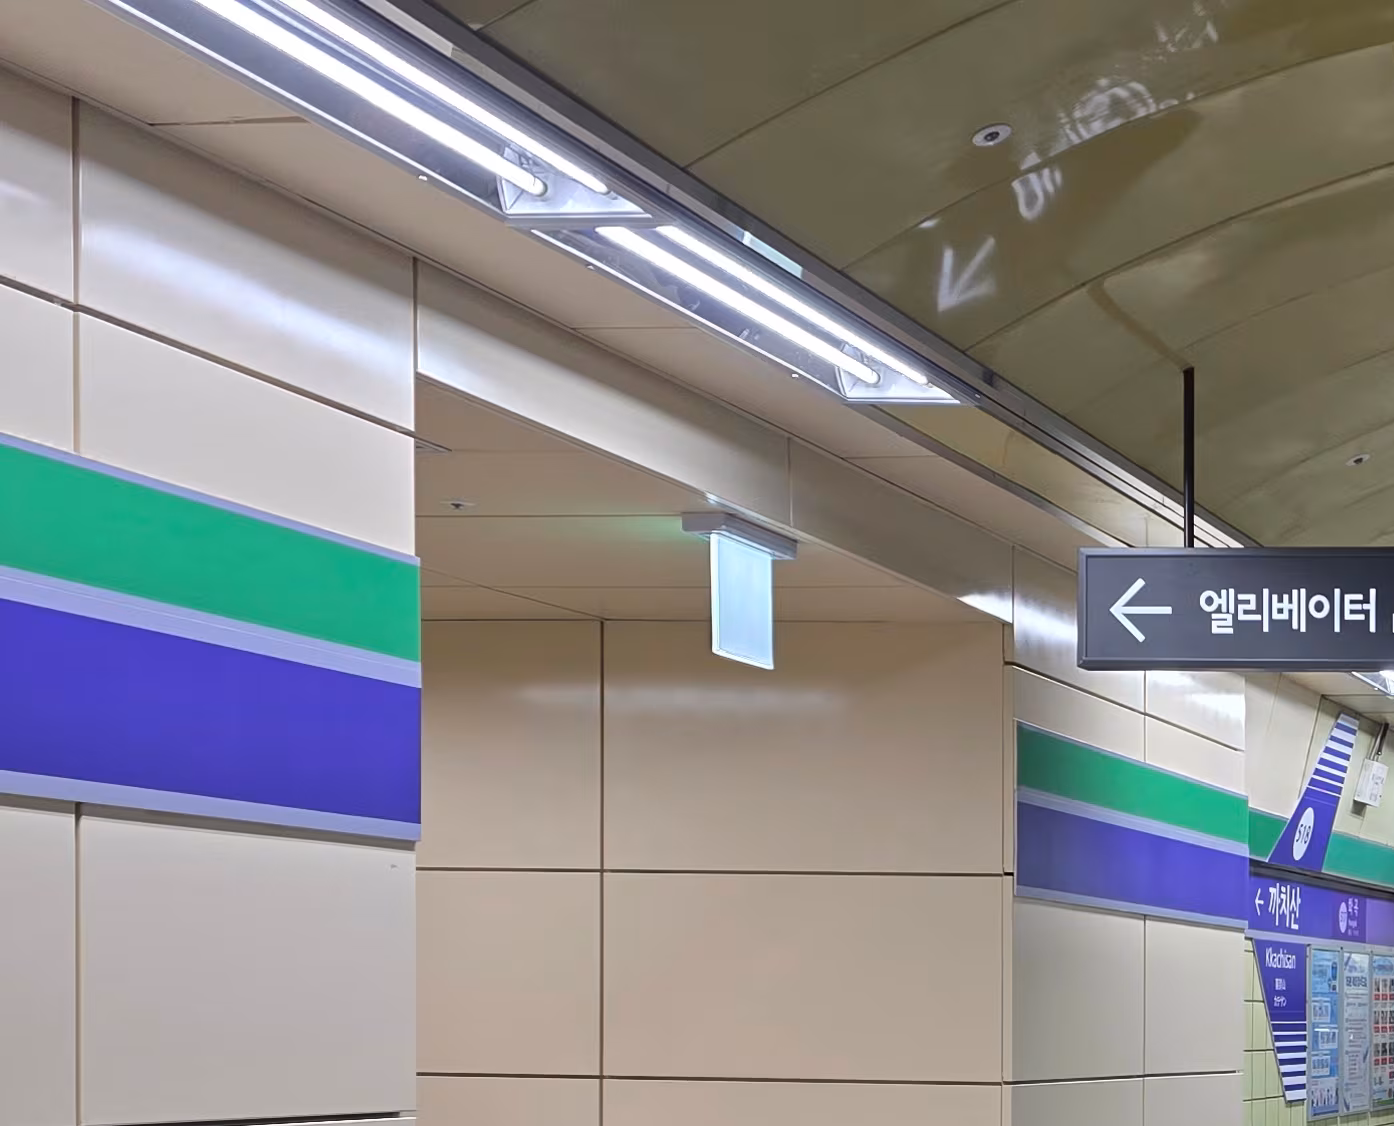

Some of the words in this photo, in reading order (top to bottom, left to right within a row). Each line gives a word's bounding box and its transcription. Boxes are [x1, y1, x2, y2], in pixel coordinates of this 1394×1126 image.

[1199, 587, 1376, 634] 엘리베이터
[1268, 882, 1302, 930] 까치산
[1265, 946, 1296, 969] Kkachisan
